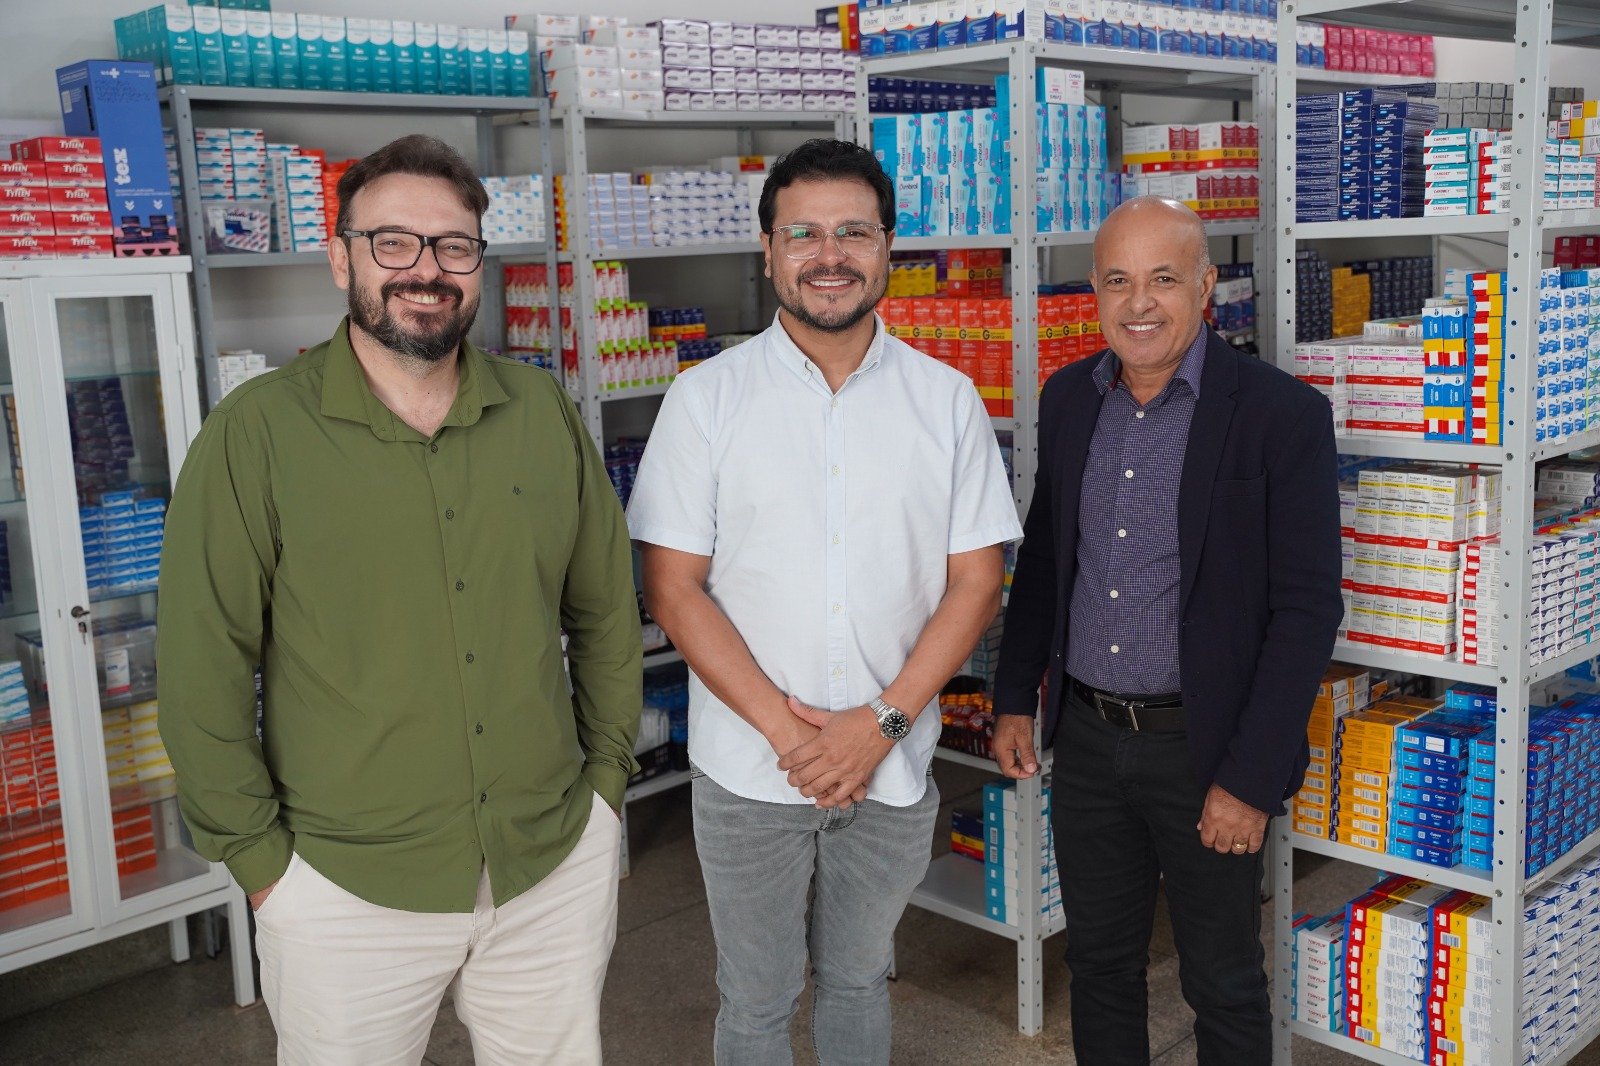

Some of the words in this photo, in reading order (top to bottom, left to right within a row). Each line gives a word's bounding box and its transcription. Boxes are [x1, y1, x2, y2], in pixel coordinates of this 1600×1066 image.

[969, 270, 975, 279] G
[986, 269, 992, 277] G
[890, 327, 896, 336] G
[913, 328, 920, 337] G
[1063, 326, 1069, 335] G
[1082, 323, 1088, 333] G
[935, 328, 942, 338] G
[960, 329, 967, 339] G
[983, 330, 990, 340] G
[1046, 328, 1052, 338] G
